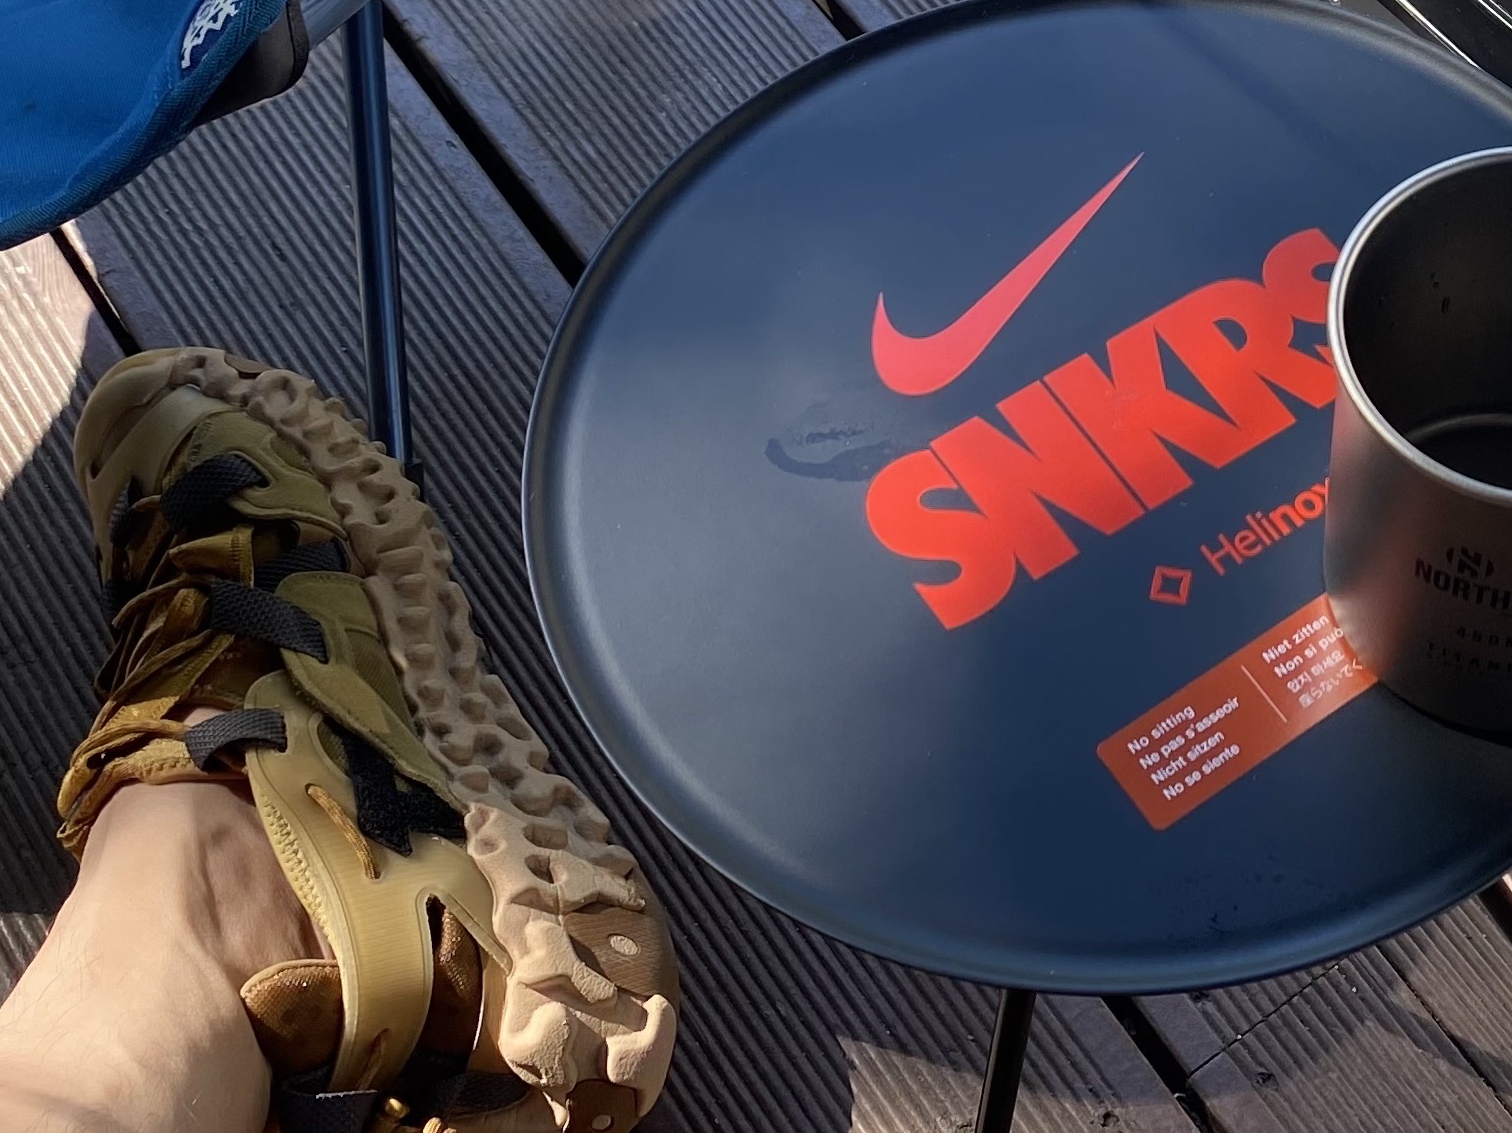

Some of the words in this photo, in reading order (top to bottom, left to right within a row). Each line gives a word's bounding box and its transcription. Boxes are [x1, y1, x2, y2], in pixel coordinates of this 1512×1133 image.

[1262, 639, 1292, 664] Niet
[1292, 615, 1330, 645] zitten
[1274, 655, 1303, 678] Non
[1304, 643, 1318, 659] si
[1127, 736, 1150, 755] No
[1151, 706, 1196, 739] sitting
[1139, 752, 1160, 770] Ne
[1160, 735, 1185, 758] pas
[1185, 697, 1239, 739] s'asseoir
[1151, 756, 1187, 785] Nicht
[1187, 731, 1225, 761] sitzen
[1163, 782, 1184, 801] No
[1184, 770, 1202, 786] se
[1201, 744, 1240, 775] siente
